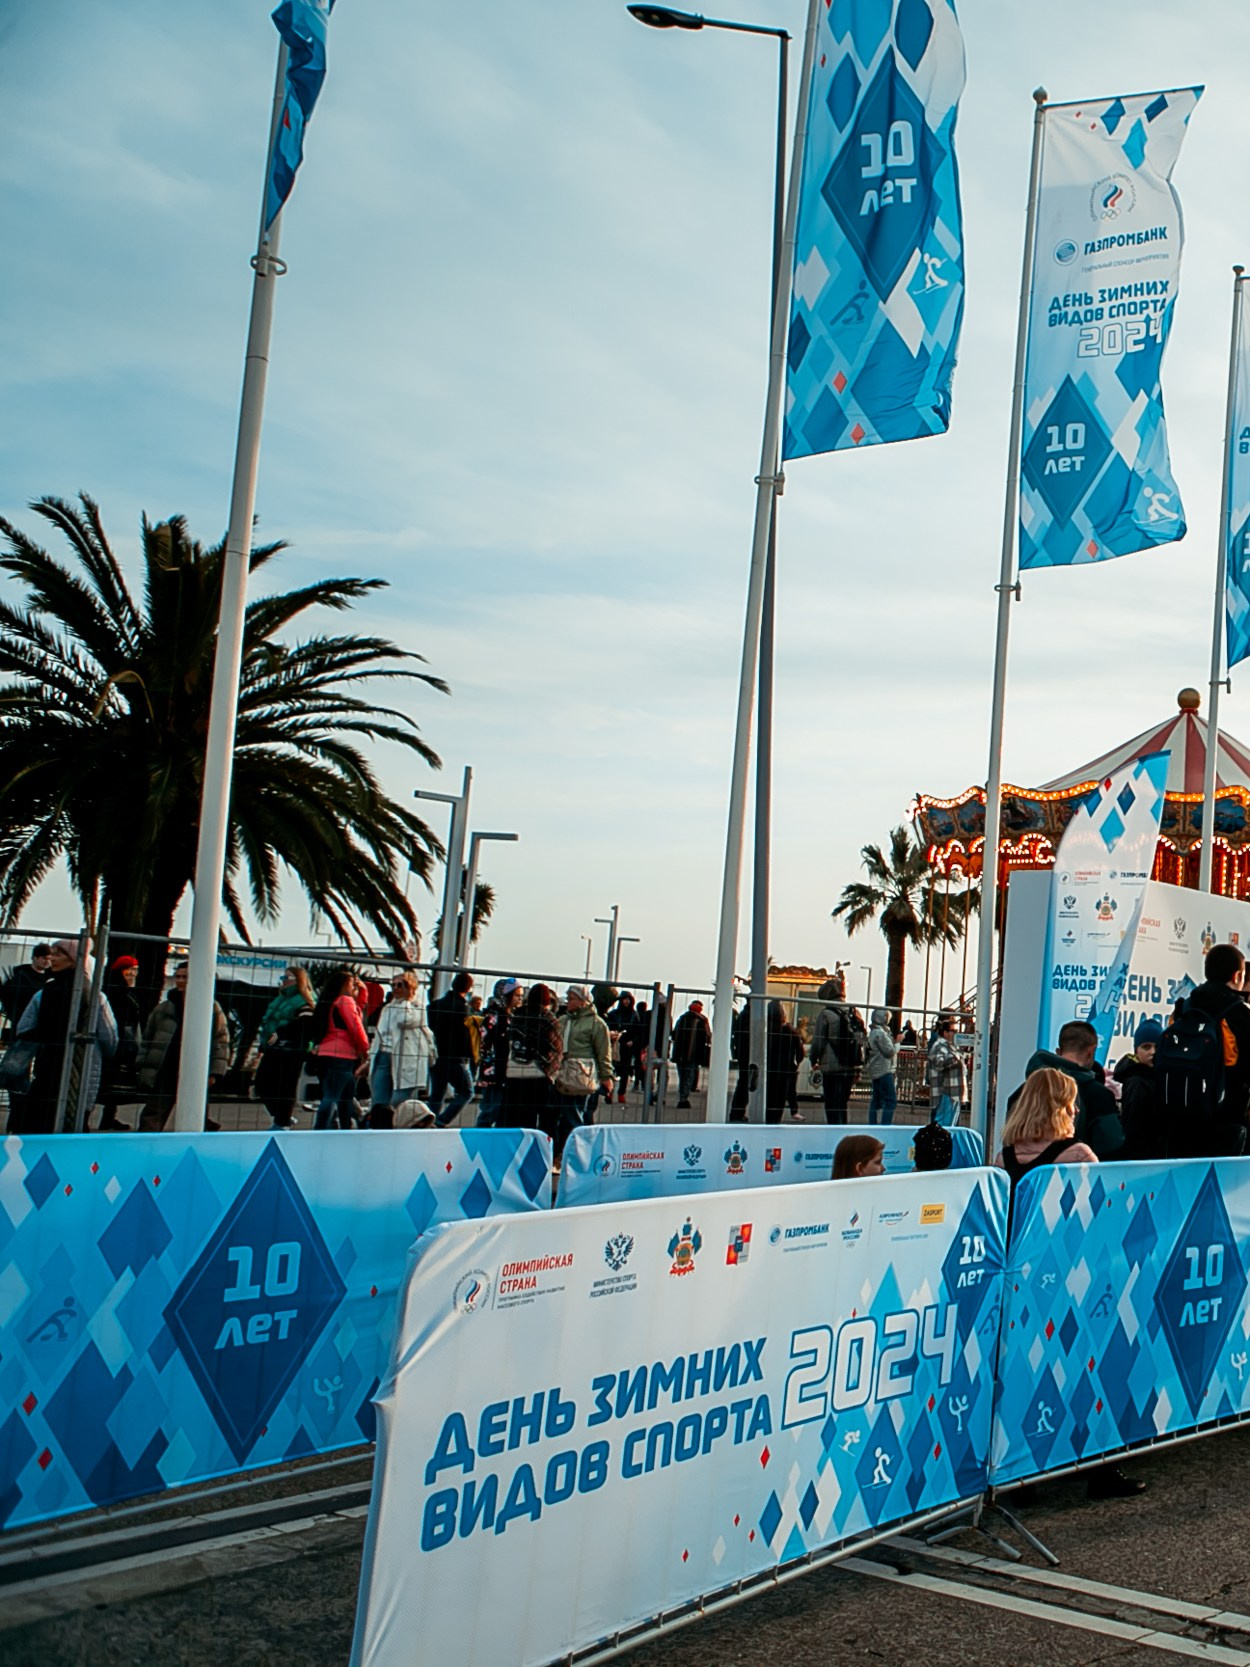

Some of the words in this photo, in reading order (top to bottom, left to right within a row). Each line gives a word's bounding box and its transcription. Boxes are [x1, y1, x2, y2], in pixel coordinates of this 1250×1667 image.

[860, 120, 915, 178] 10
[1084, 227, 1168, 255] ГАЗПРОМБАНК
[1048, 292, 1094, 313] ДЕНЬ
[1098, 280, 1170, 303] ЗИМНИХ
[1048, 308, 1104, 327] ВИДОВ
[1108, 298, 1167, 318] СПОРТА
[1077, 316, 1164, 358] 2024
[1046, 422, 1086, 453] 10
[1052, 978, 1096, 992] ВИДОВ
[1053, 965, 1088, 977] ДЕНЬ
[1122, 974, 1162, 1005] ЕНЬ
[784, 1223, 830, 1239] ГАЗПРОМБАНК
[501, 1253, 574, 1278] ОЛИМПИЙСКАЯ
[959, 1236, 987, 1265] 10
[223, 1241, 301, 1302] 10
[1183, 1244, 1225, 1291] 10
[499, 1276, 537, 1294] СТРАНА
[781, 1302, 959, 1431] 2024
[424, 1387, 576, 1486] ДЕНЬ
[587, 1336, 767, 1428] ЗИМНИХ
[420, 1440, 610, 1552] ВИДОВ
[621, 1393, 773, 1479] СПОРТА
